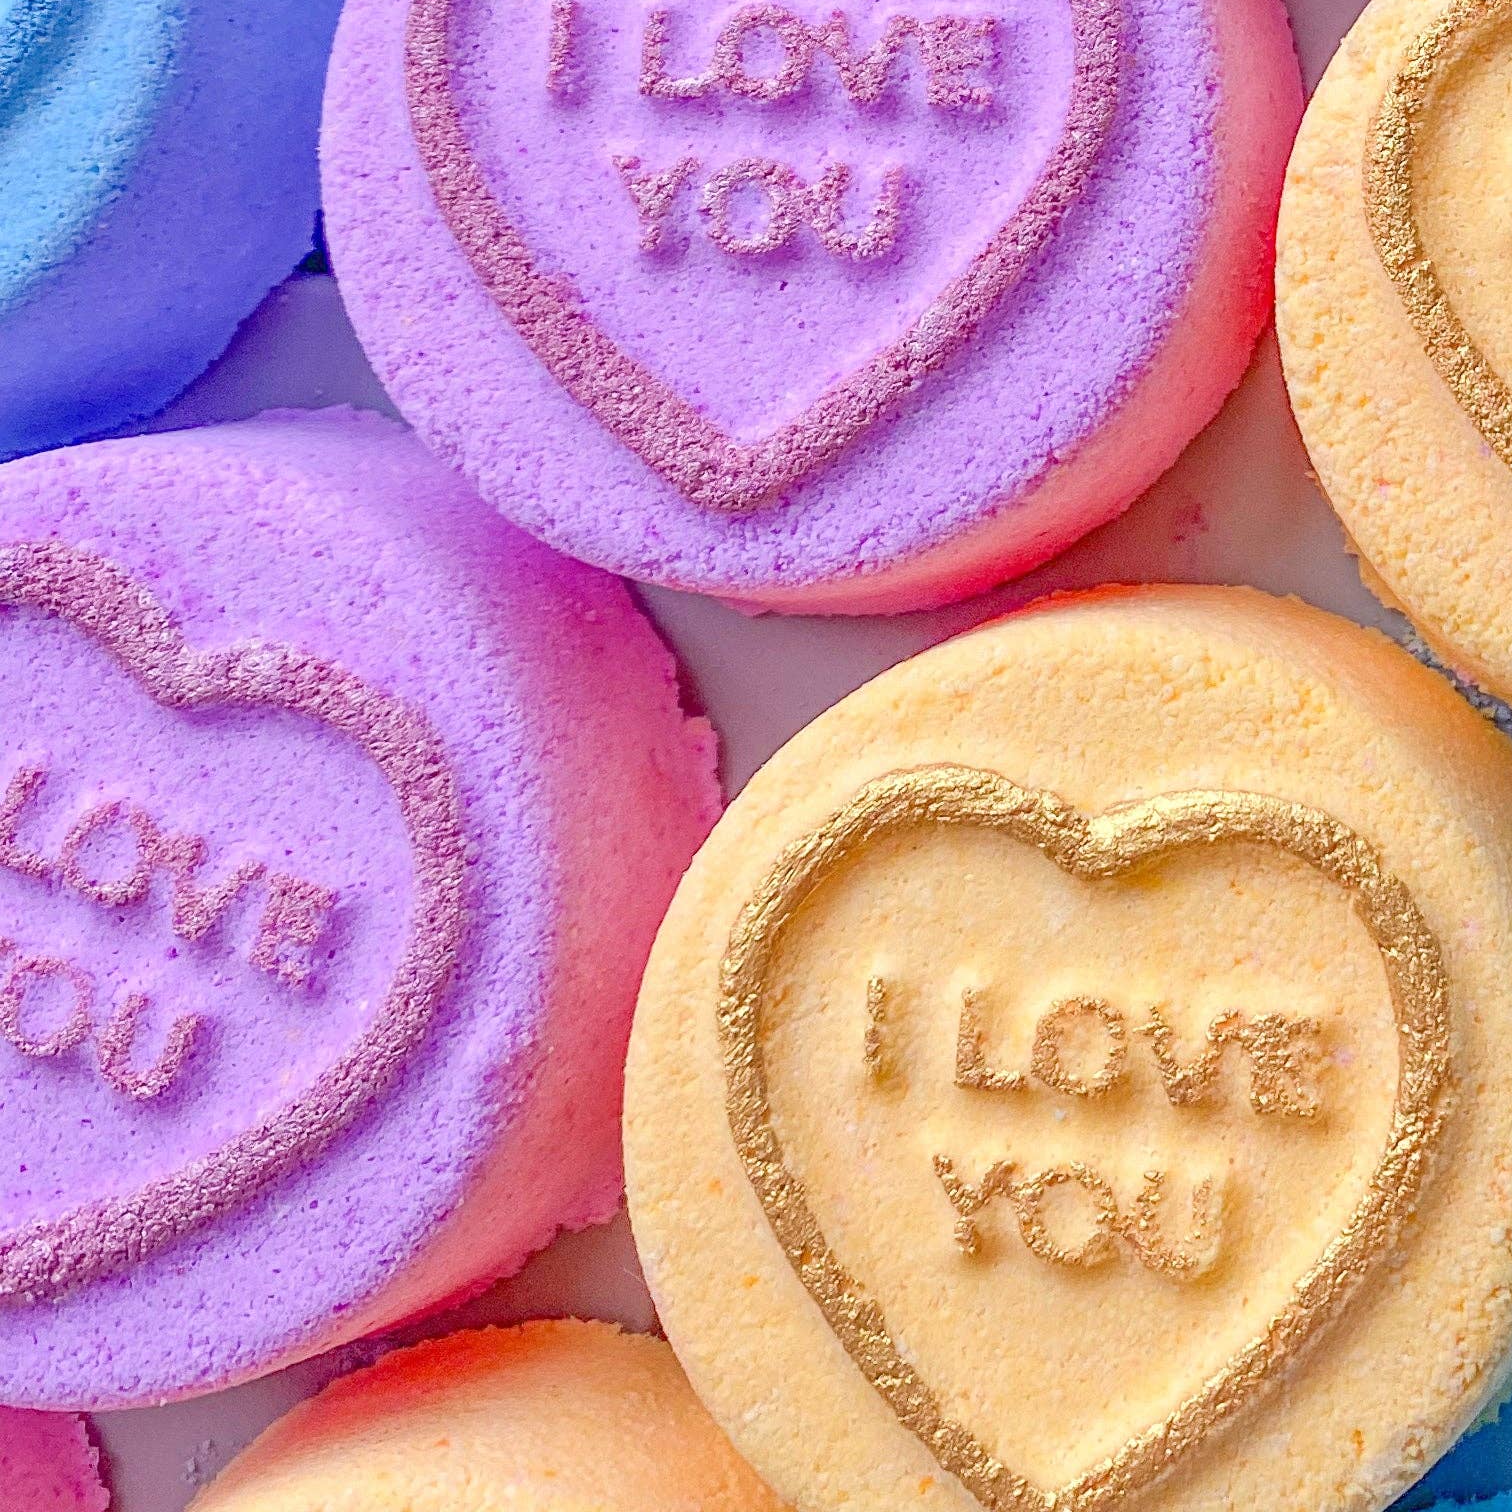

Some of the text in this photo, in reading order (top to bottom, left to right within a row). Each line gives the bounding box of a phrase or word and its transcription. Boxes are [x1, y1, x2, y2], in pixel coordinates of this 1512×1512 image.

[639, 2, 1000, 110] LOVE
[611, 155, 905, 262] YOU
[0, 765, 340, 990] LOVE
[0, 938, 208, 1102] OU
[864, 975, 1322, 1120] I LOVE
[932, 1152, 1222, 1281] YOU
